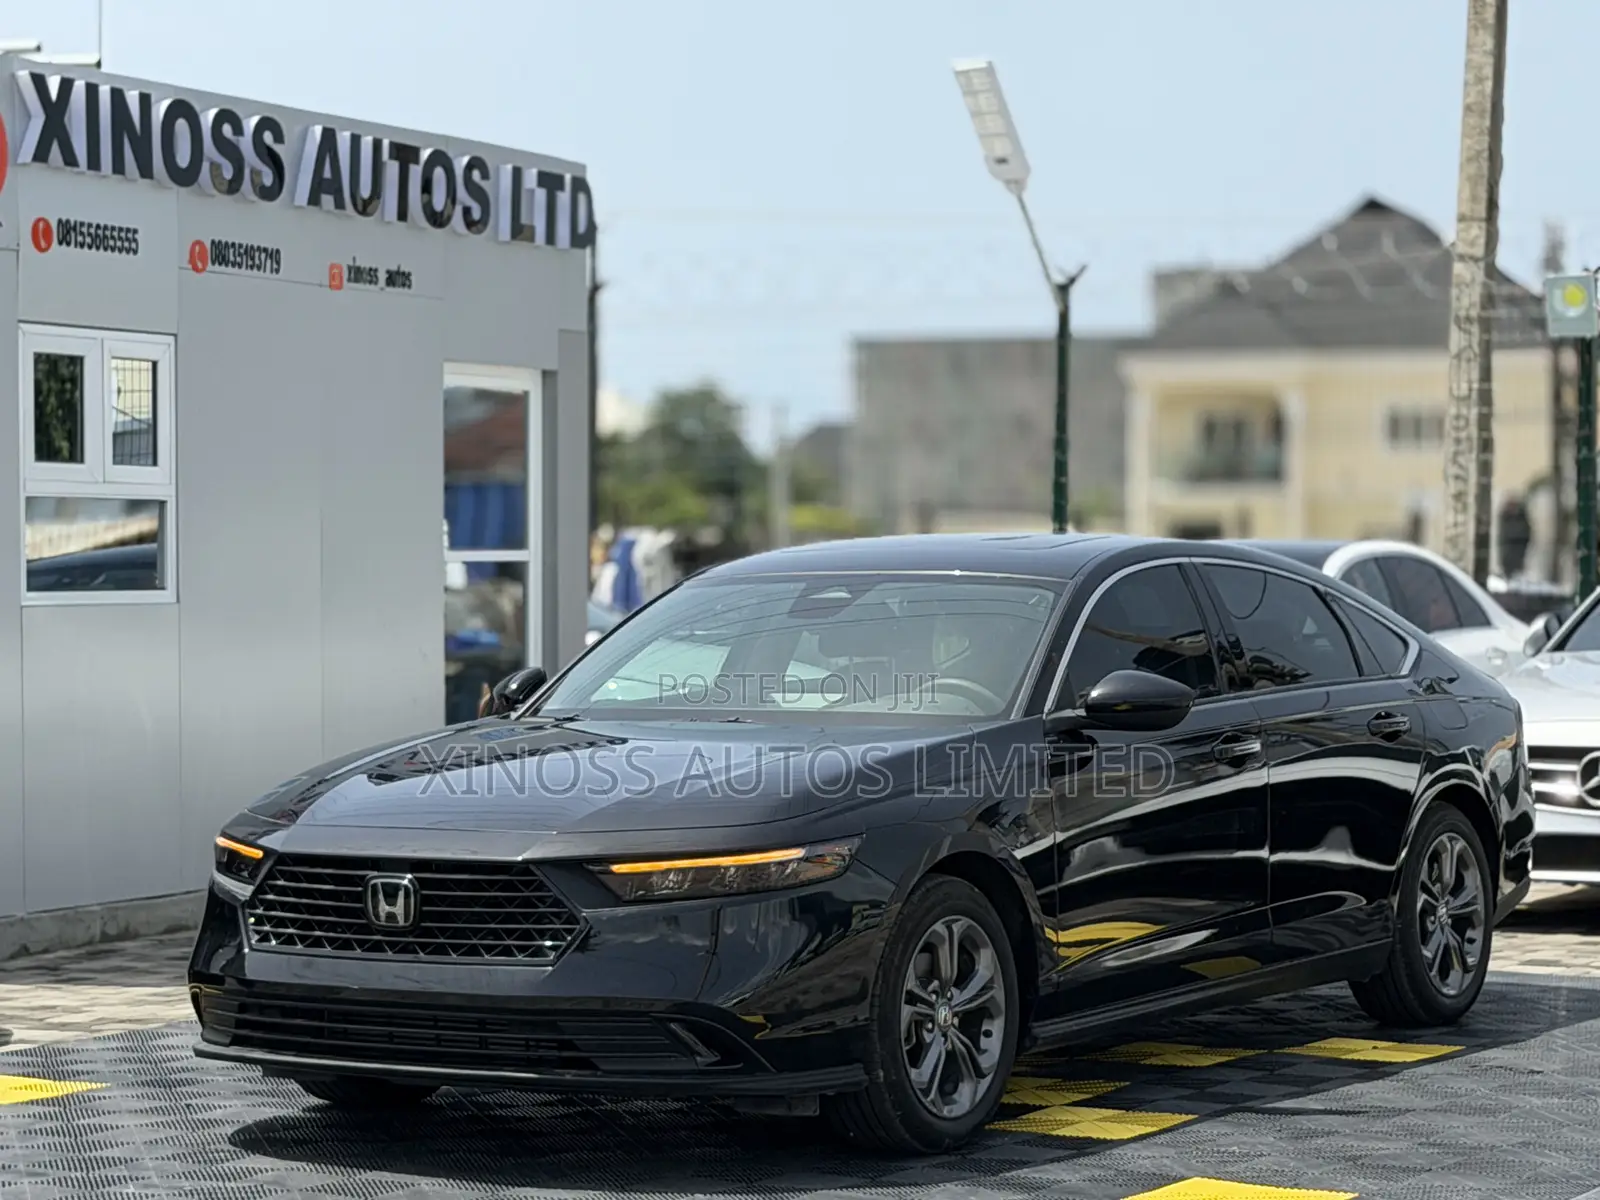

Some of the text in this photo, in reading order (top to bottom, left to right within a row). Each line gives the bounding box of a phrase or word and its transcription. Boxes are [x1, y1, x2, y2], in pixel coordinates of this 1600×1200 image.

[18, 70, 597, 250] XINOSS AUTOS LTD
[56, 217, 139, 256] 08155665555
[210, 238, 281, 275] 08035193719
